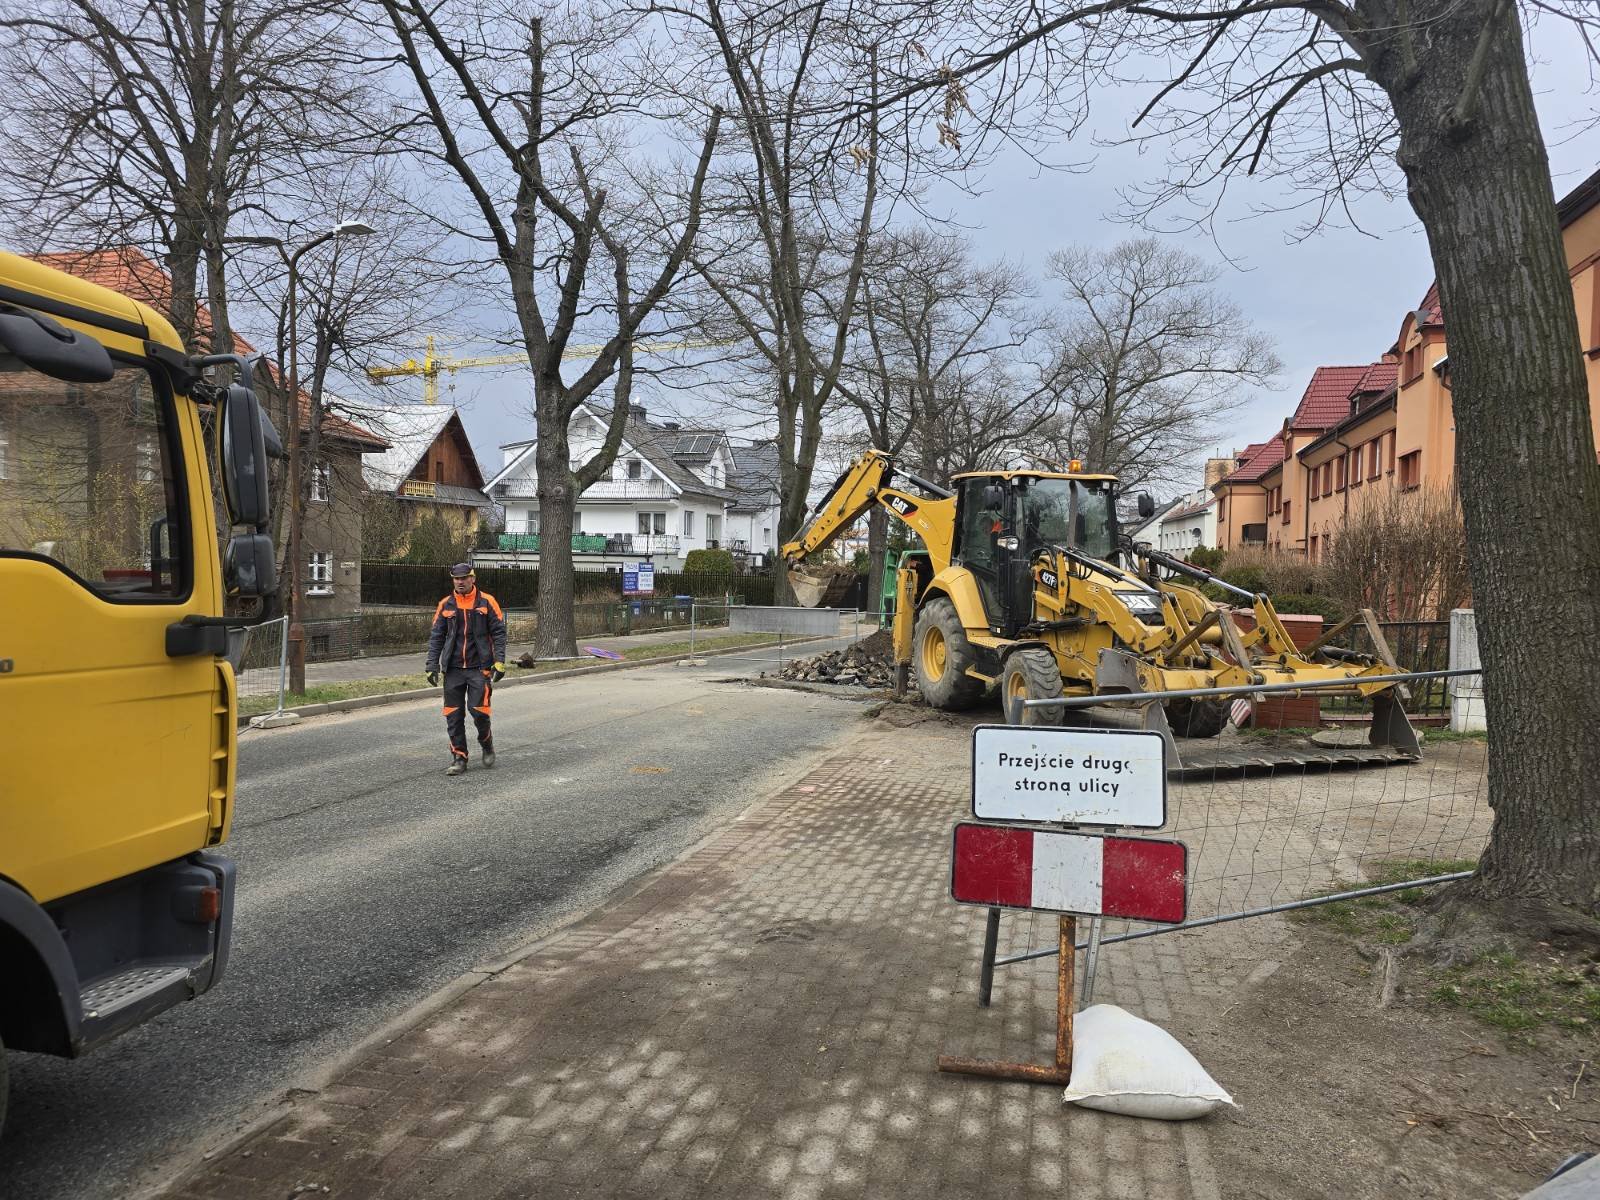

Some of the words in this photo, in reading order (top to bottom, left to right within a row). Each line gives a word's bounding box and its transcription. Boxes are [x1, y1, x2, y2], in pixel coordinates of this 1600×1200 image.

[891, 496, 909, 514] CAT
[999, 752, 1074, 772] Przejście
[1014, 777, 1071, 796] stroną
[1079, 778, 1120, 797] ulicy
